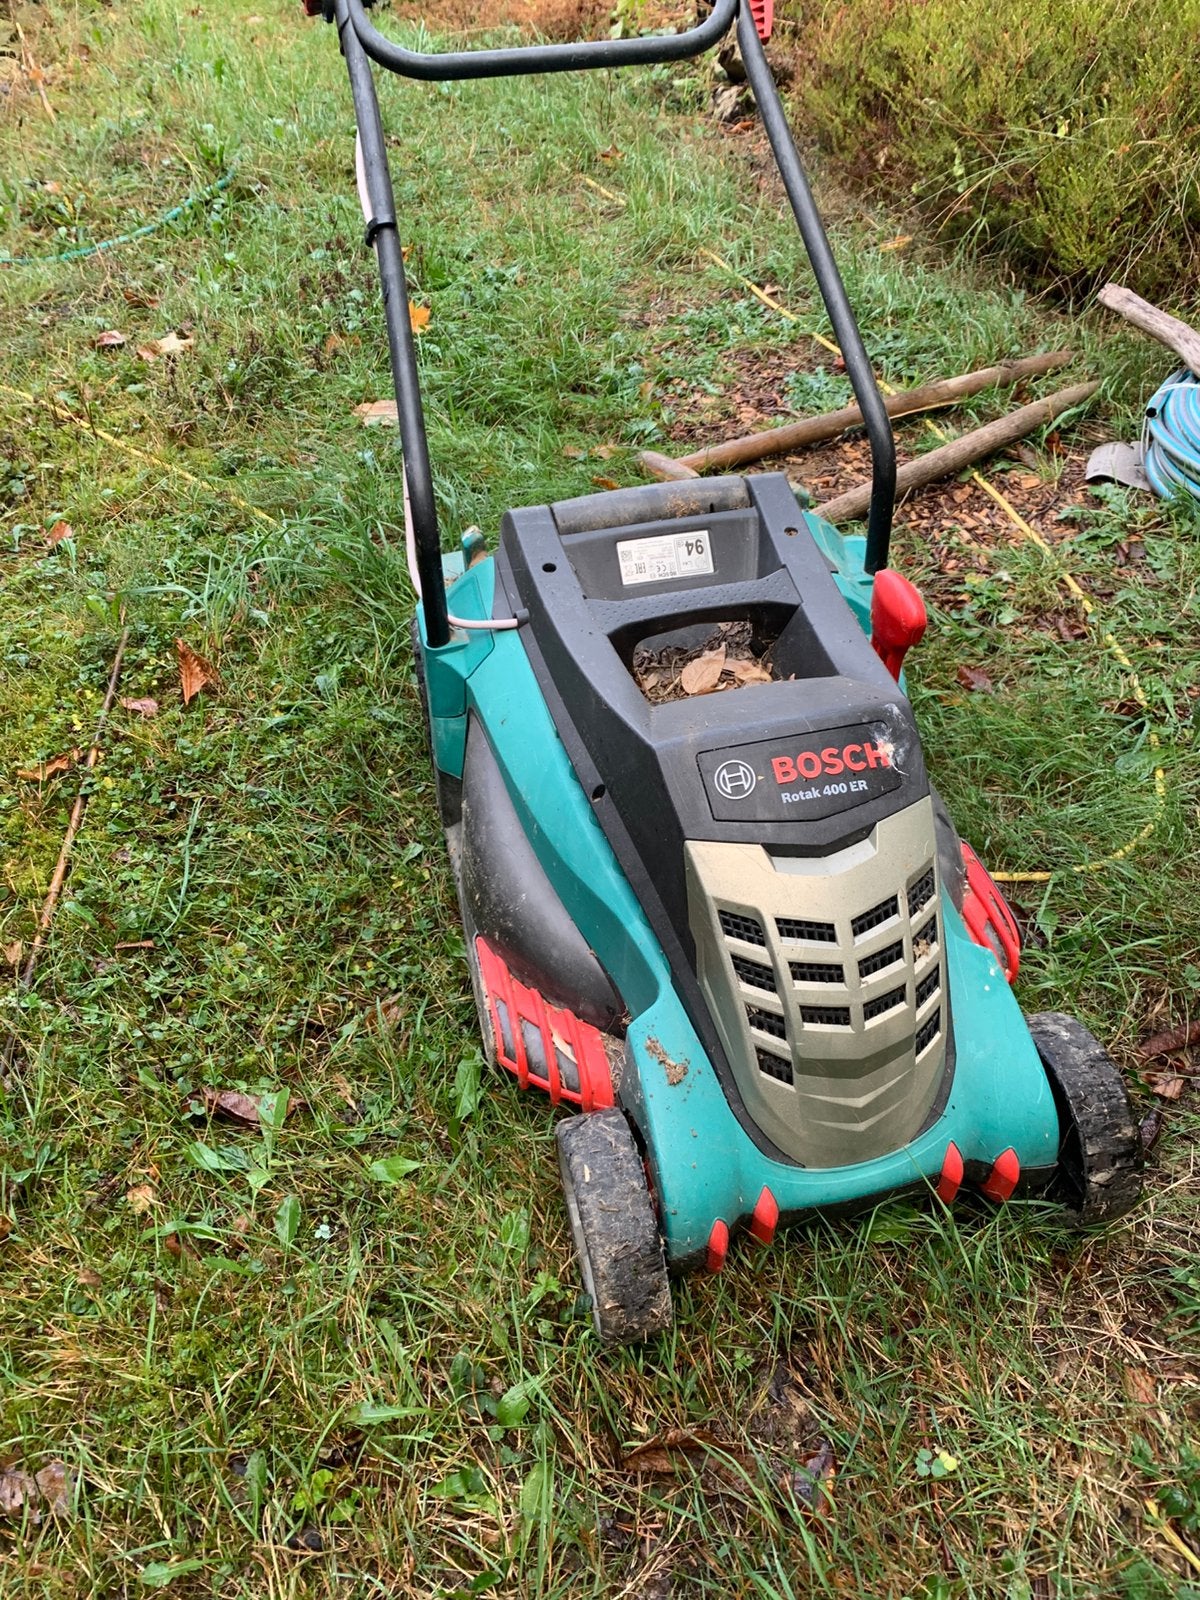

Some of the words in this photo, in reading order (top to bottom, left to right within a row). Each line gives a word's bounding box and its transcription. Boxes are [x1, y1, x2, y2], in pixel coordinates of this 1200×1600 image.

[685, 539, 704, 556] 94
[771, 742, 890, 784] BOSCH
[781, 787, 821, 804] Rotak
[823, 782, 847, 797] 400
[849, 780, 868, 792] ER
